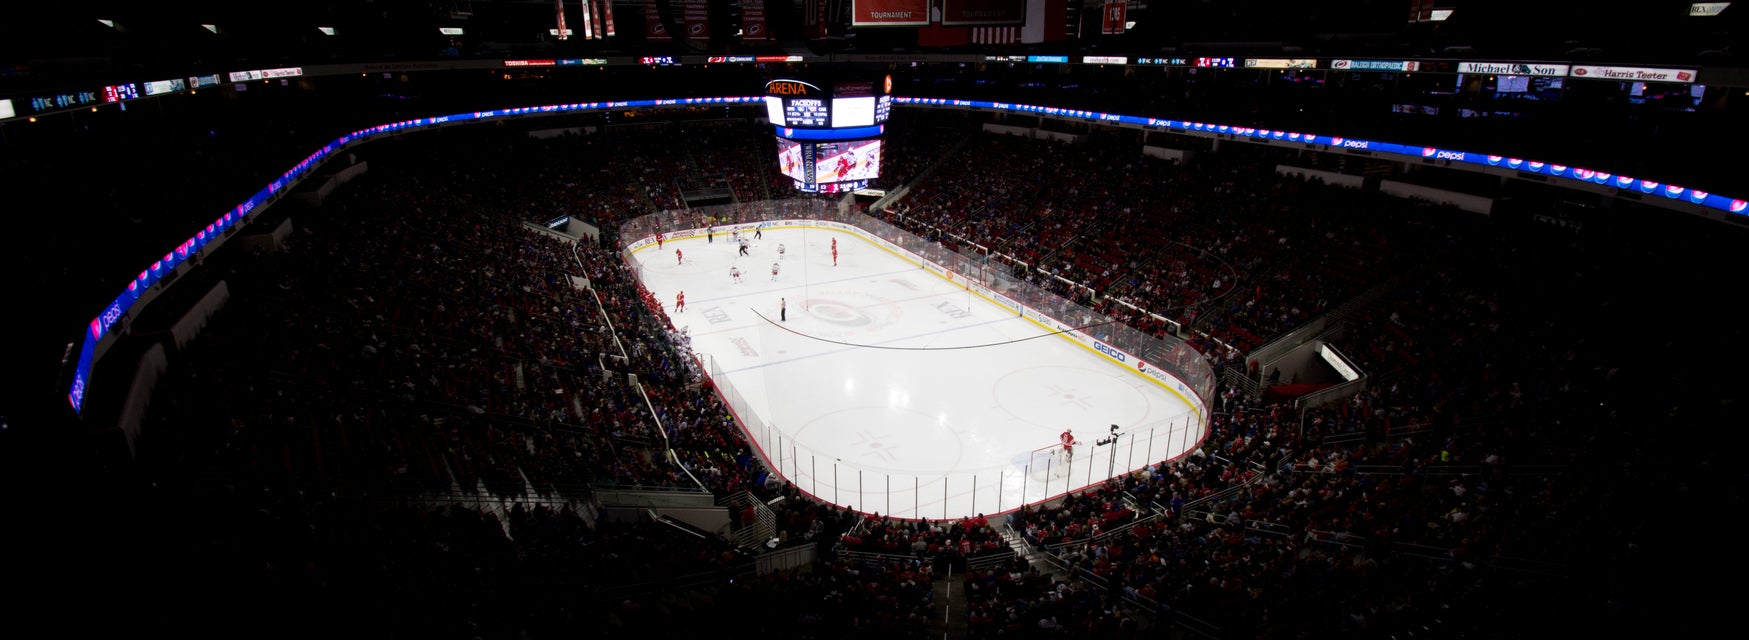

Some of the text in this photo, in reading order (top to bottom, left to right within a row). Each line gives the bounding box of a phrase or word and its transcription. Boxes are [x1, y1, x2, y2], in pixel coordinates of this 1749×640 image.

[1467, 63, 1510, 74] Michael
[1533, 65, 1556, 75] Son
[1604, 69, 1668, 80] Harris Teeter
[769, 80, 807, 95] ARENA
[1344, 140, 1369, 149] pepsi
[1437, 150, 1465, 160] pepsi
[1093, 340, 1126, 363] GEICO
[1146, 367, 1168, 382] pepsi
